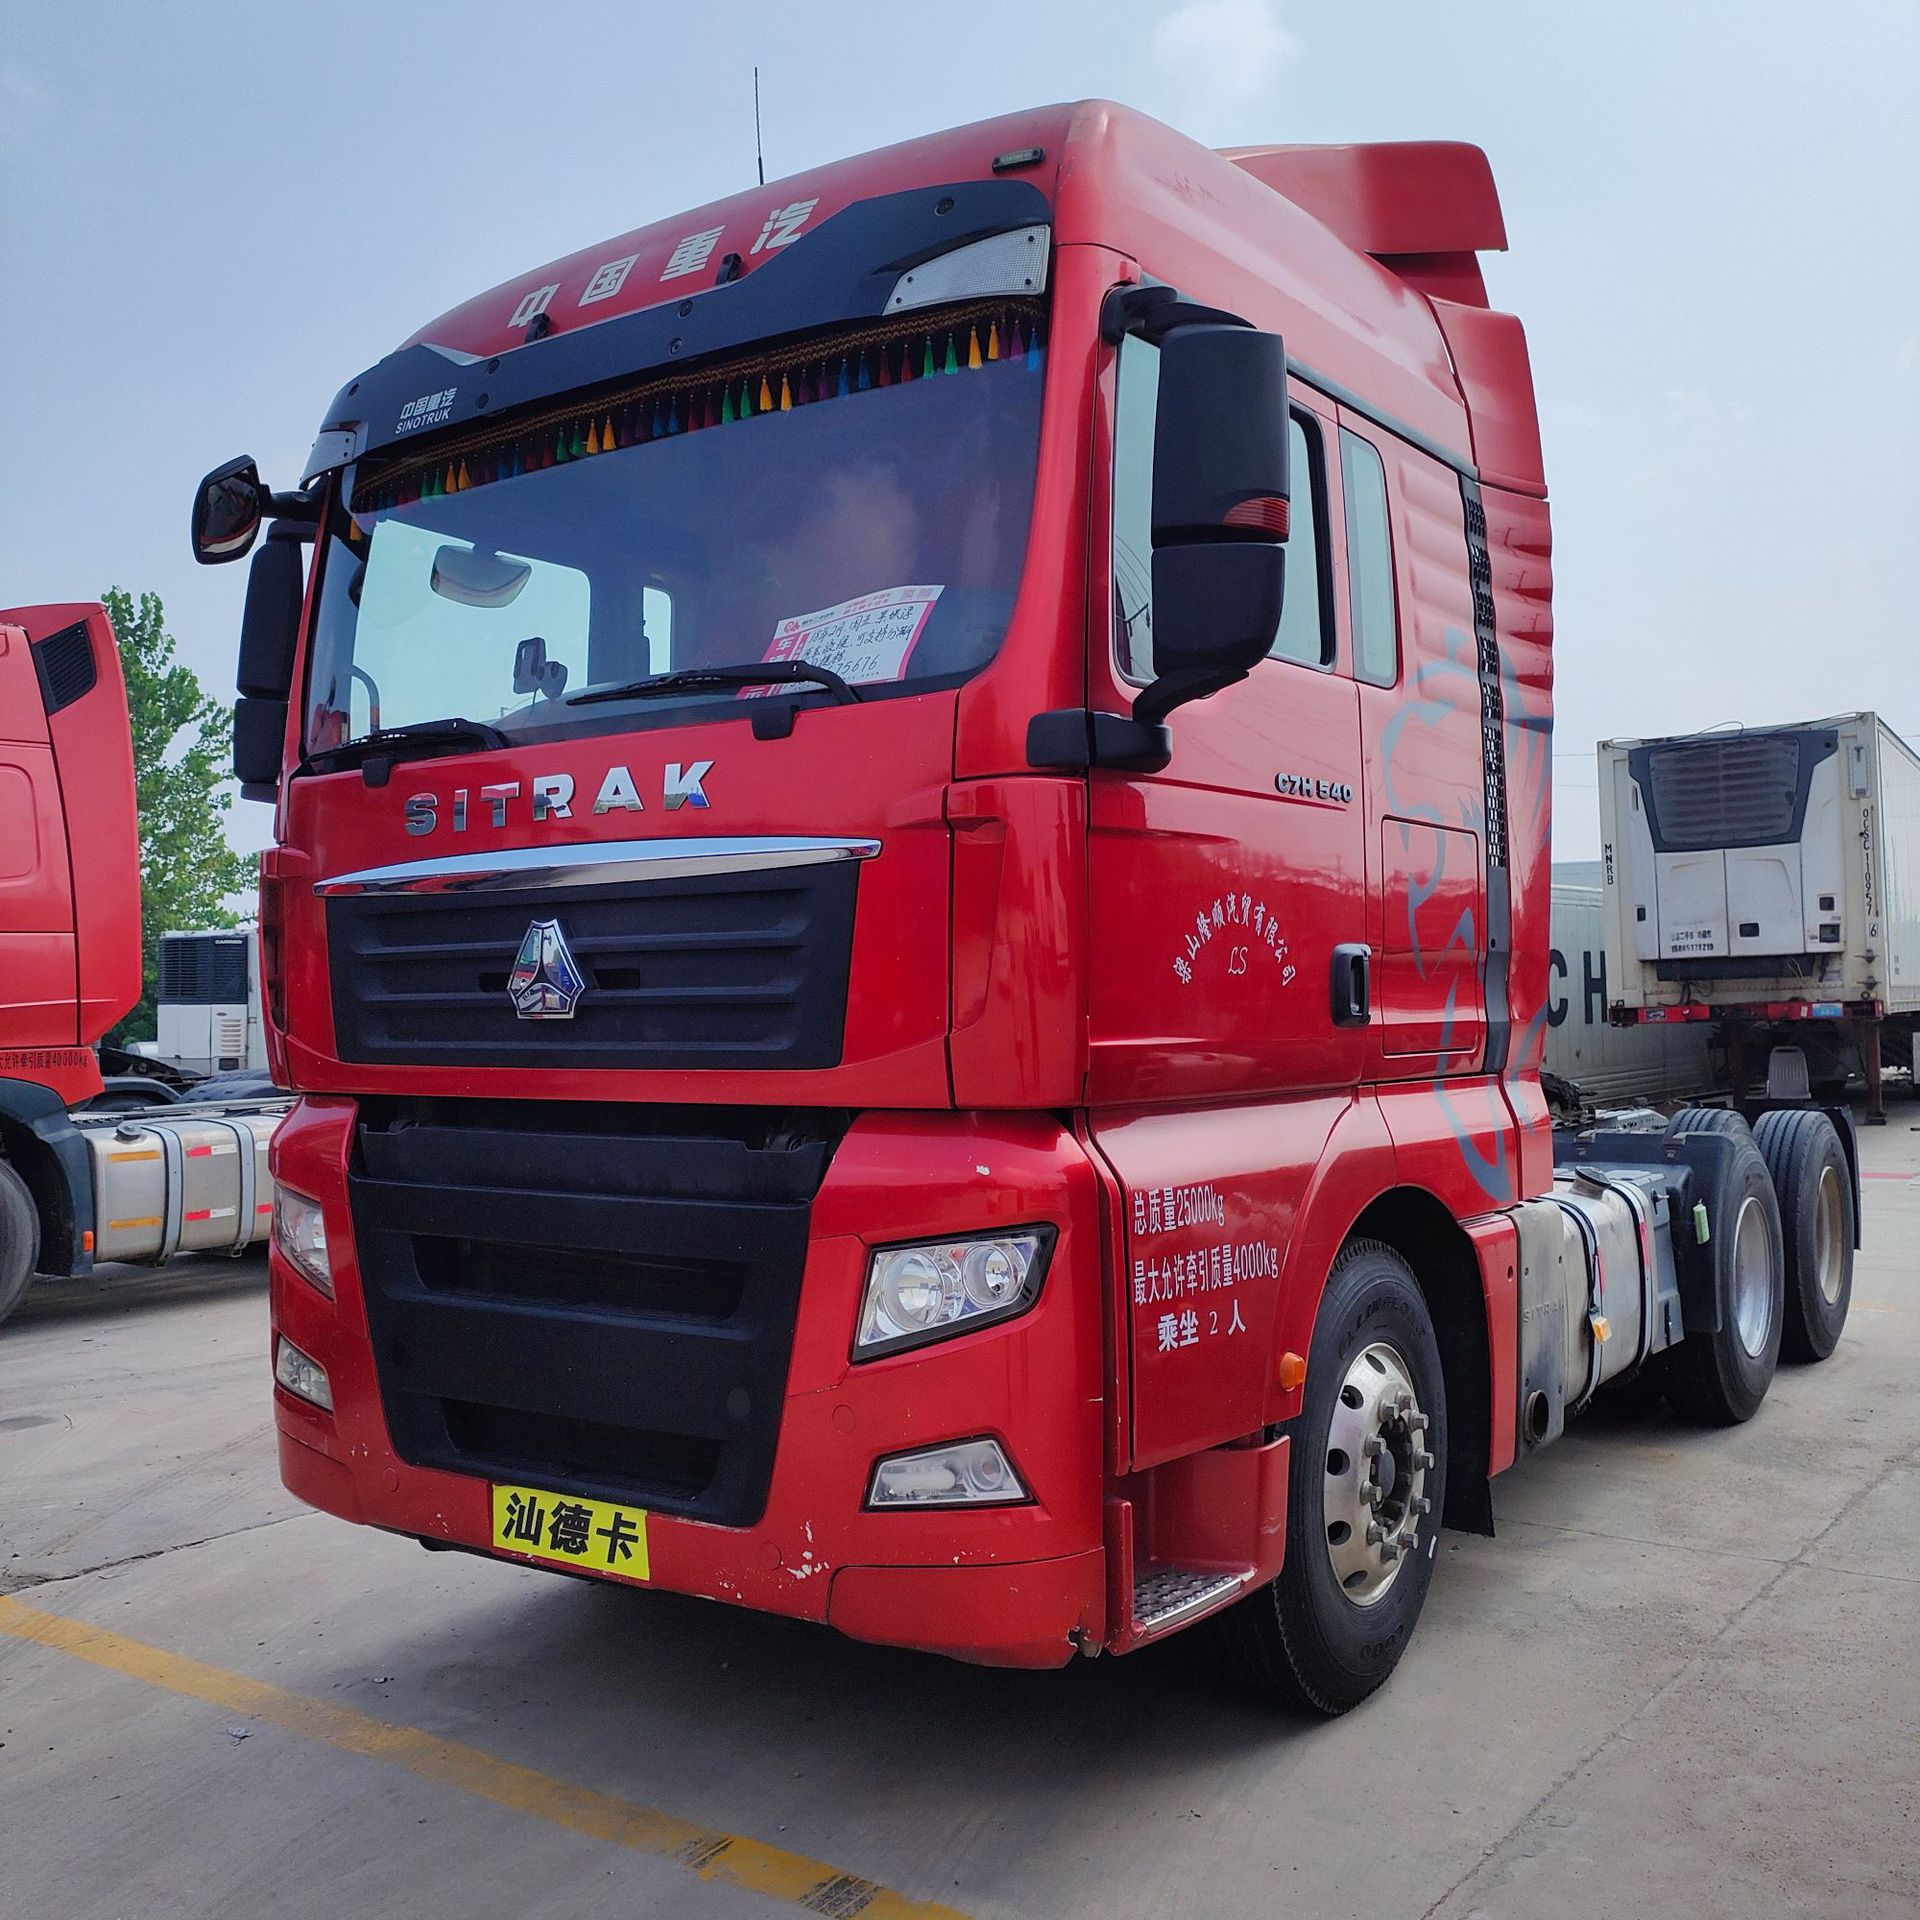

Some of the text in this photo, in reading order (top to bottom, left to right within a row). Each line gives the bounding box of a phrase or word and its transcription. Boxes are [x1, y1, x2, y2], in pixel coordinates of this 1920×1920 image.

[508, 198, 819, 328] 中国重汽
[395, 407, 451, 434] SINOTRUK
[400, 387, 458, 420] 中国重汽
[404, 760, 715, 837] SITRAK
[1275, 772, 1353, 803] C7H 540
[1870, 924, 1877, 937] 6
[1228, 946, 1248, 975] LS
[1134, 1184, 1225, 1235] 总质量25000kg
[1134, 1240, 1279, 1306] 最大允许牵引质量4000kg
[1158, 1299, 1246, 1352] 乘坐 2 人
[502, 1492, 640, 1564] 汕德卡
